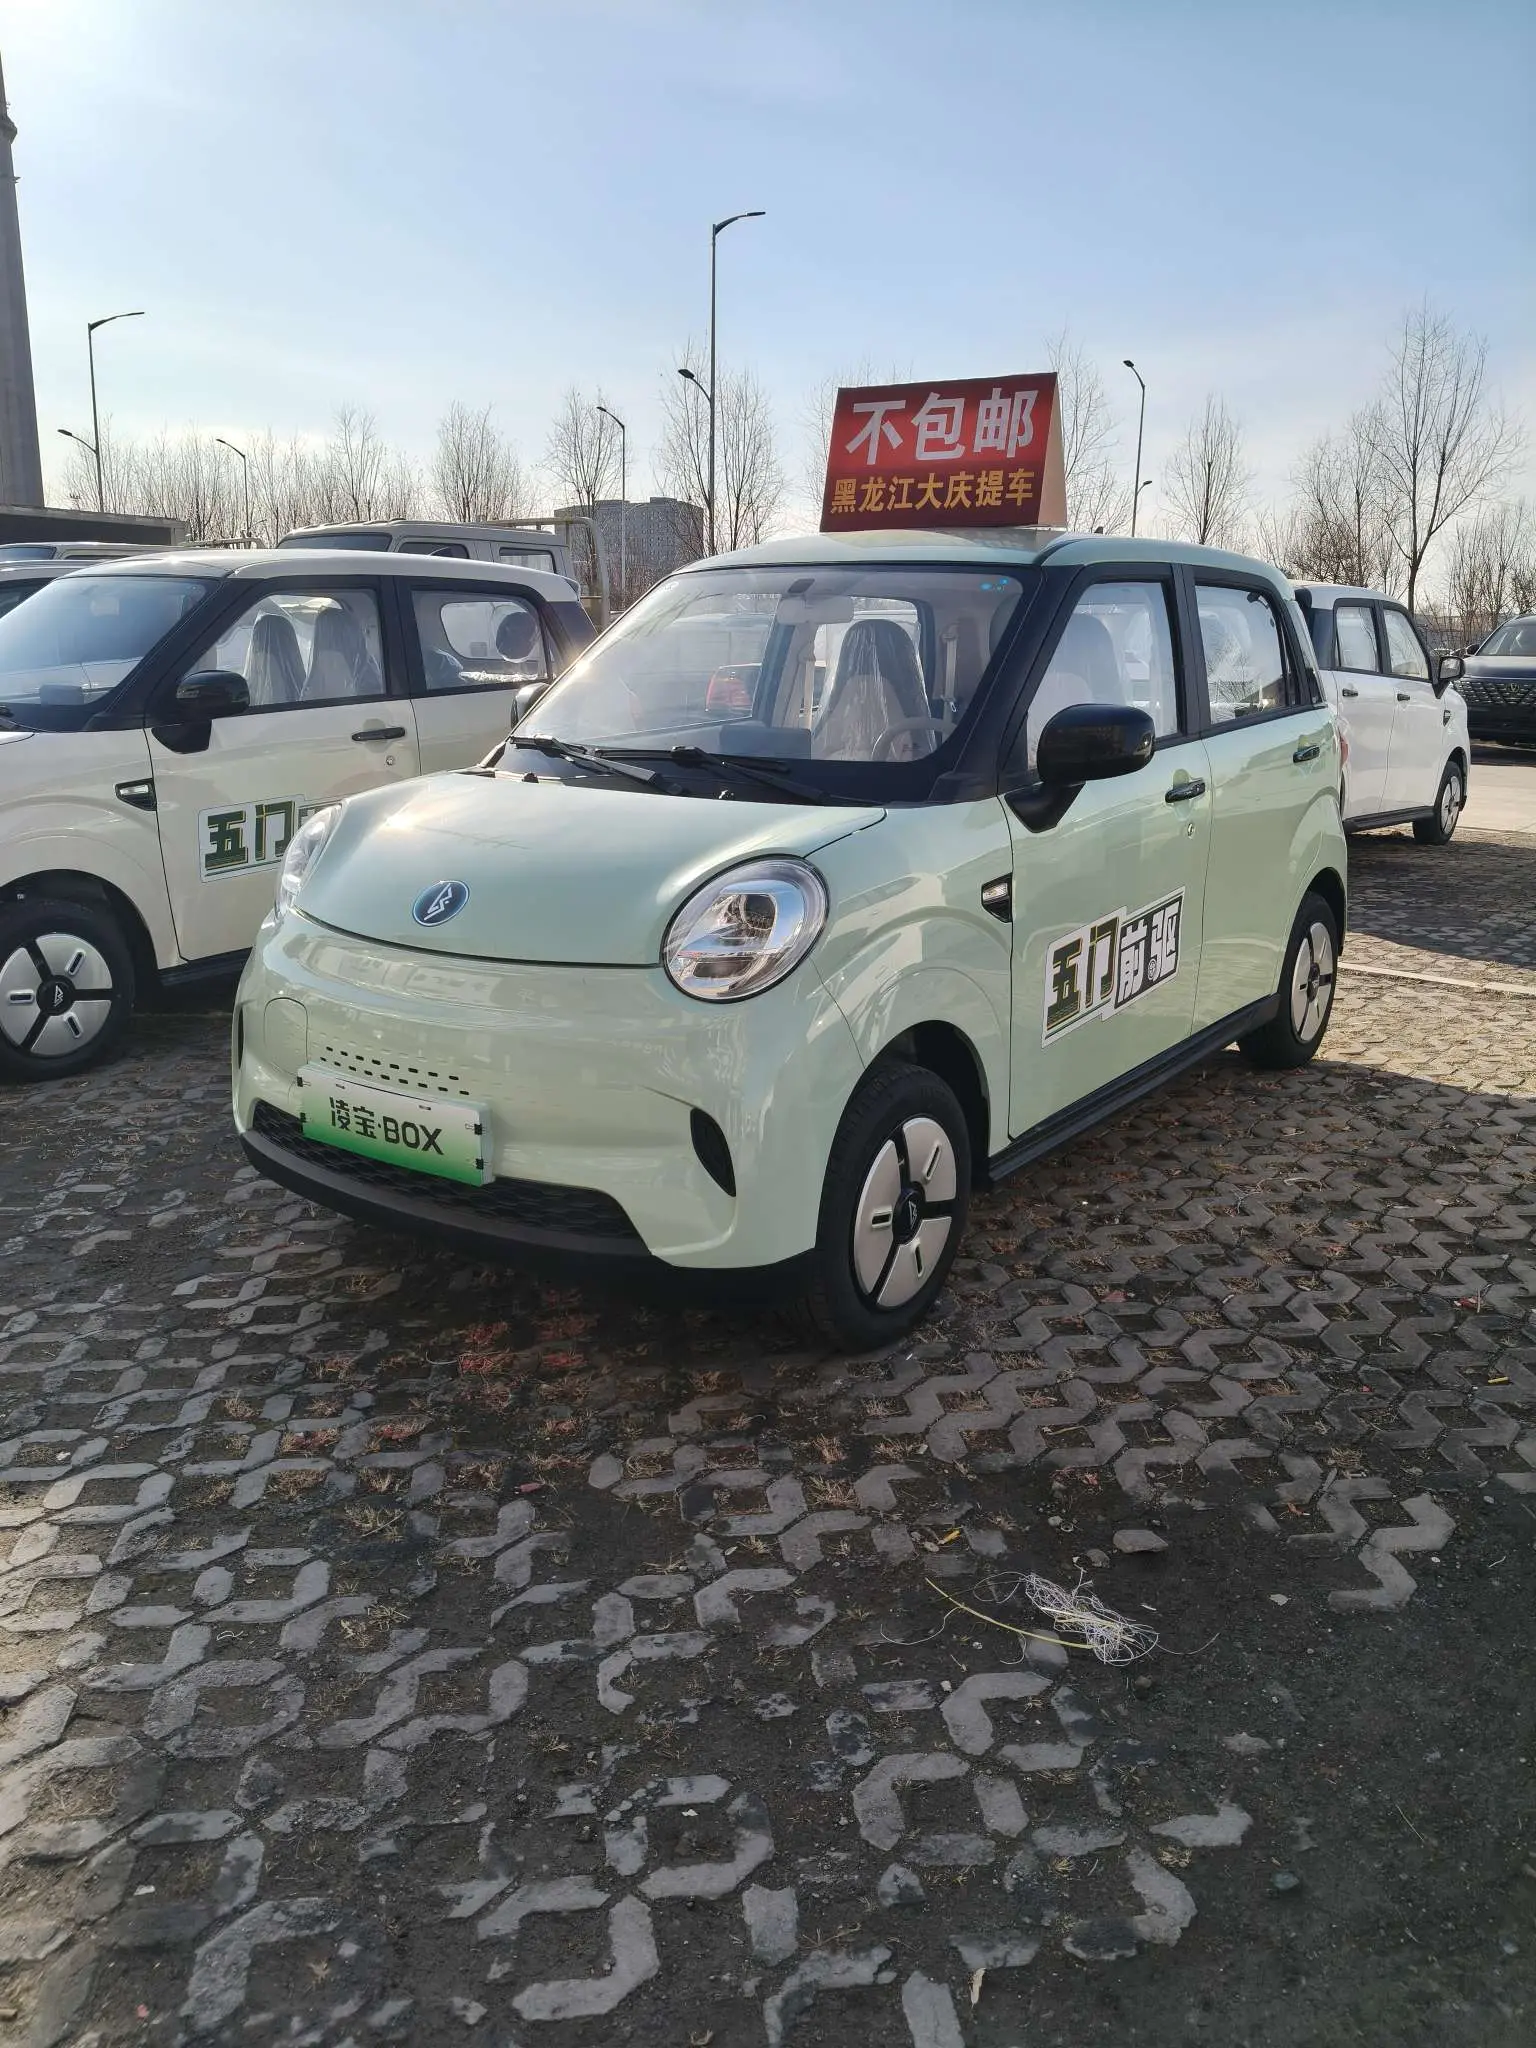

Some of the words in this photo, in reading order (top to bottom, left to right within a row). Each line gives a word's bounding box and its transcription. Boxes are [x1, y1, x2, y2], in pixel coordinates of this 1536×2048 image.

[845, 387, 1039, 465] 不包邮
[830, 468, 1035, 514] 黑龙江大庆提车
[205, 800, 317, 871] 五门
[1046, 901, 1181, 1031] 五门前驱
